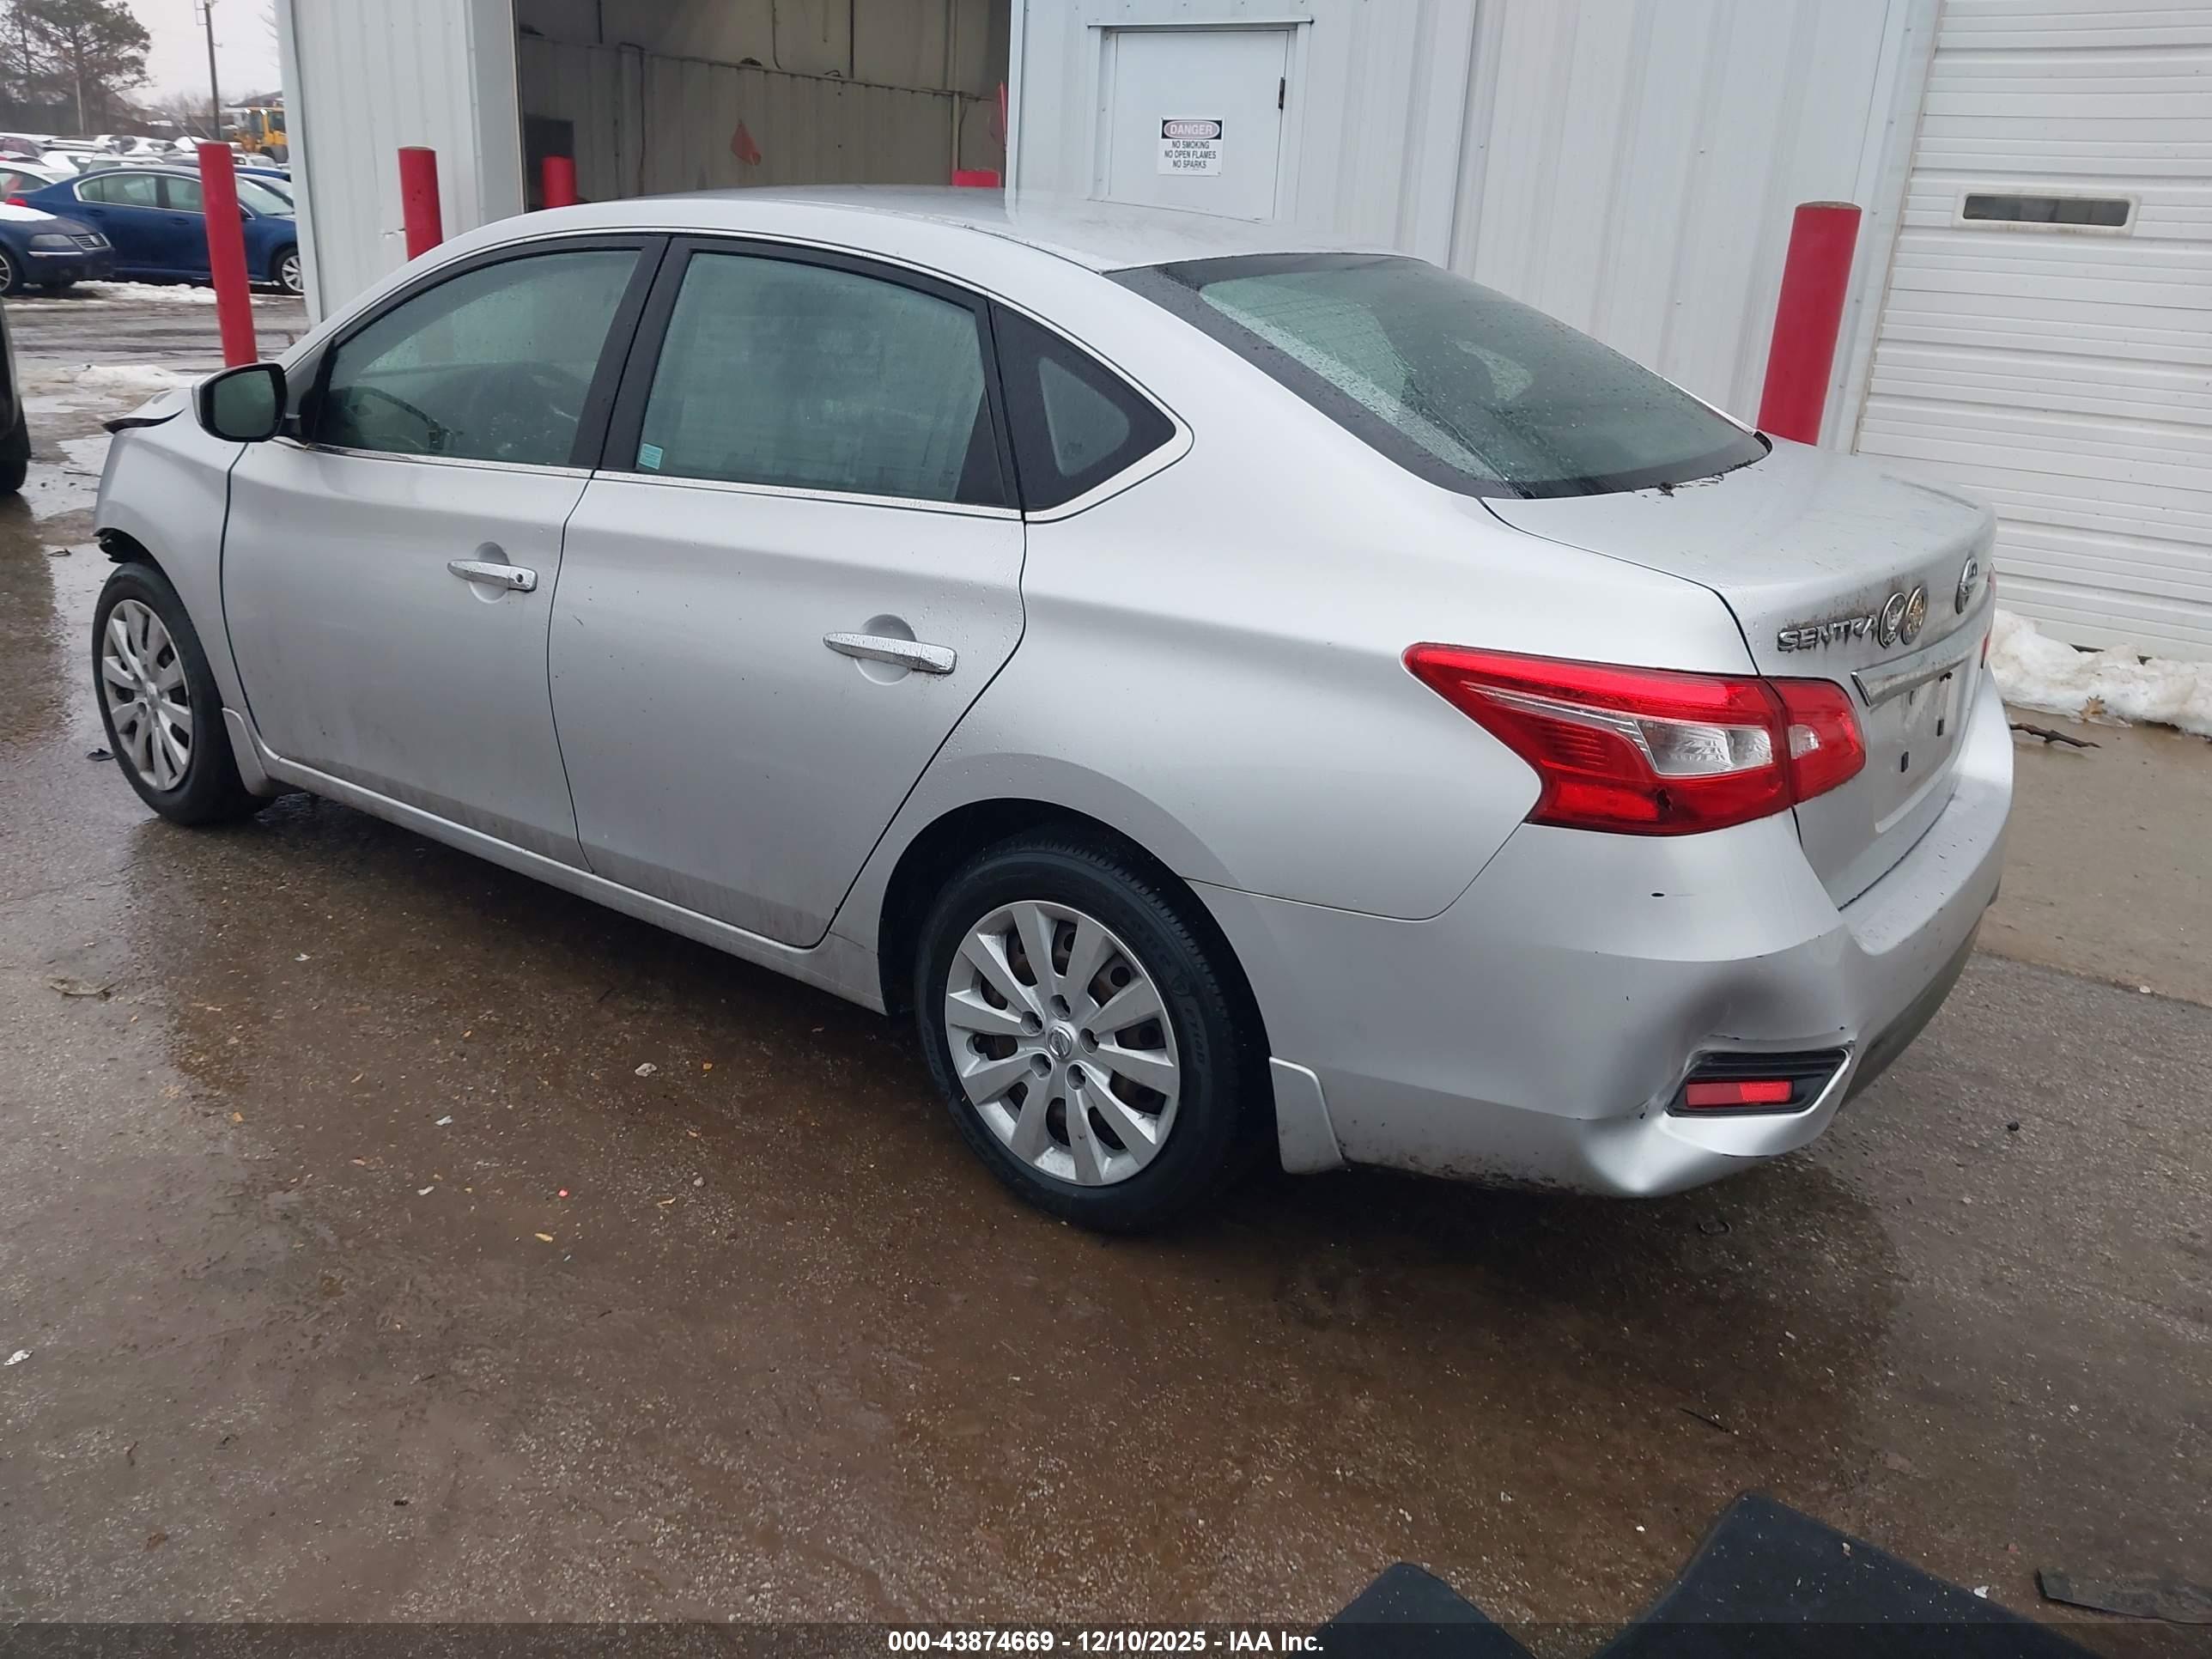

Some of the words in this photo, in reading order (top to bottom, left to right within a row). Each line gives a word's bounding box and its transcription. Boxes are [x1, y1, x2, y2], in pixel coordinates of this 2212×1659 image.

[1170, 124, 1213, 135] DANGER
[1172, 141, 1181, 149] NO
[1182, 141, 1210, 149] SMOKING
[1164, 149, 1173, 158] NO
[1174, 150, 1191, 159] OPEN
[1192, 151, 1217, 160] FLAMES
[1172, 160, 1182, 168] NO
[1182, 160, 1207, 169] SPARKS
[1778, 615, 1878, 651] SENTRA
